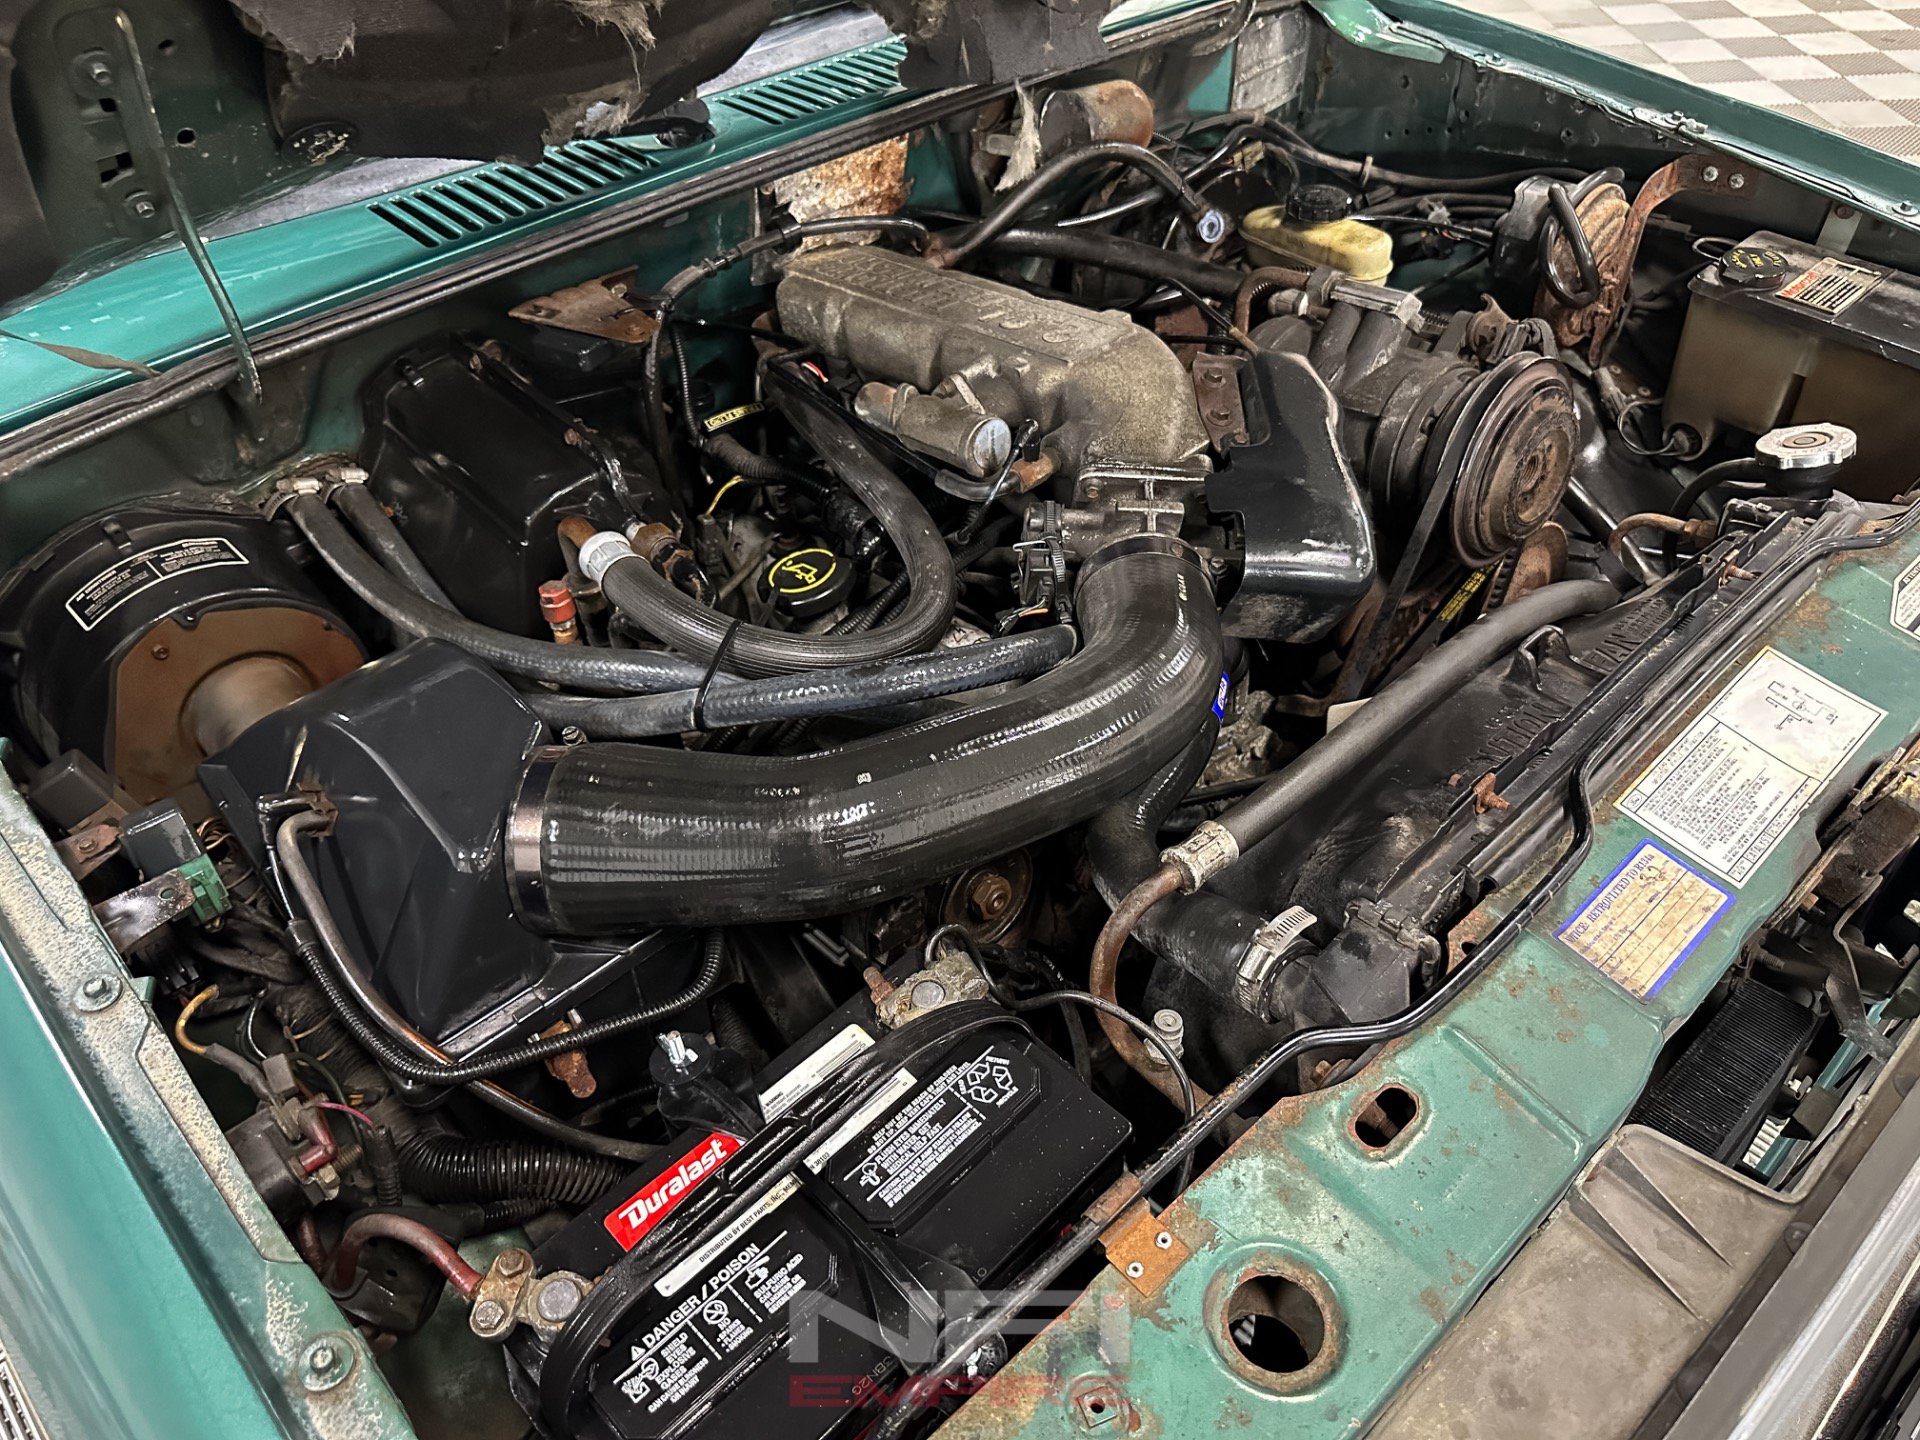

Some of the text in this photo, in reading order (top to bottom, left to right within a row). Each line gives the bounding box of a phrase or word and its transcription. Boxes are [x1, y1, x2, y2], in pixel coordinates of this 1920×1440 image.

[1626, 867, 1638, 880] TO
[1634, 850, 1654, 871] R134a
[874, 1096, 946, 1164] FLUSH EYES IMMEDIATELY
[880, 1153, 896, 1170] WITH
[918, 1121, 932, 1136] GET
[886, 1121, 942, 1175] MEDICAL HELP FAST
[618, 1138, 727, 1229] Duralast
[698, 1232, 733, 1262] DISTRIBUTED
[731, 1225, 741, 1235] BY
[739, 1214, 754, 1228] BEST
[641, 1293, 701, 1348] DANGER
[708, 1241, 760, 1290] POISON
[752, 1266, 788, 1299] SULFURIC
[757, 1273, 790, 1303] CAN CAUSE
[717, 1315, 731, 1330] NO
[660, 1331, 689, 1358] SHIELD
[665, 1342, 688, 1363] EYES
[653, 1345, 696, 1384] EXPLOSIVE
[659, 1364, 687, 1390] GASES
